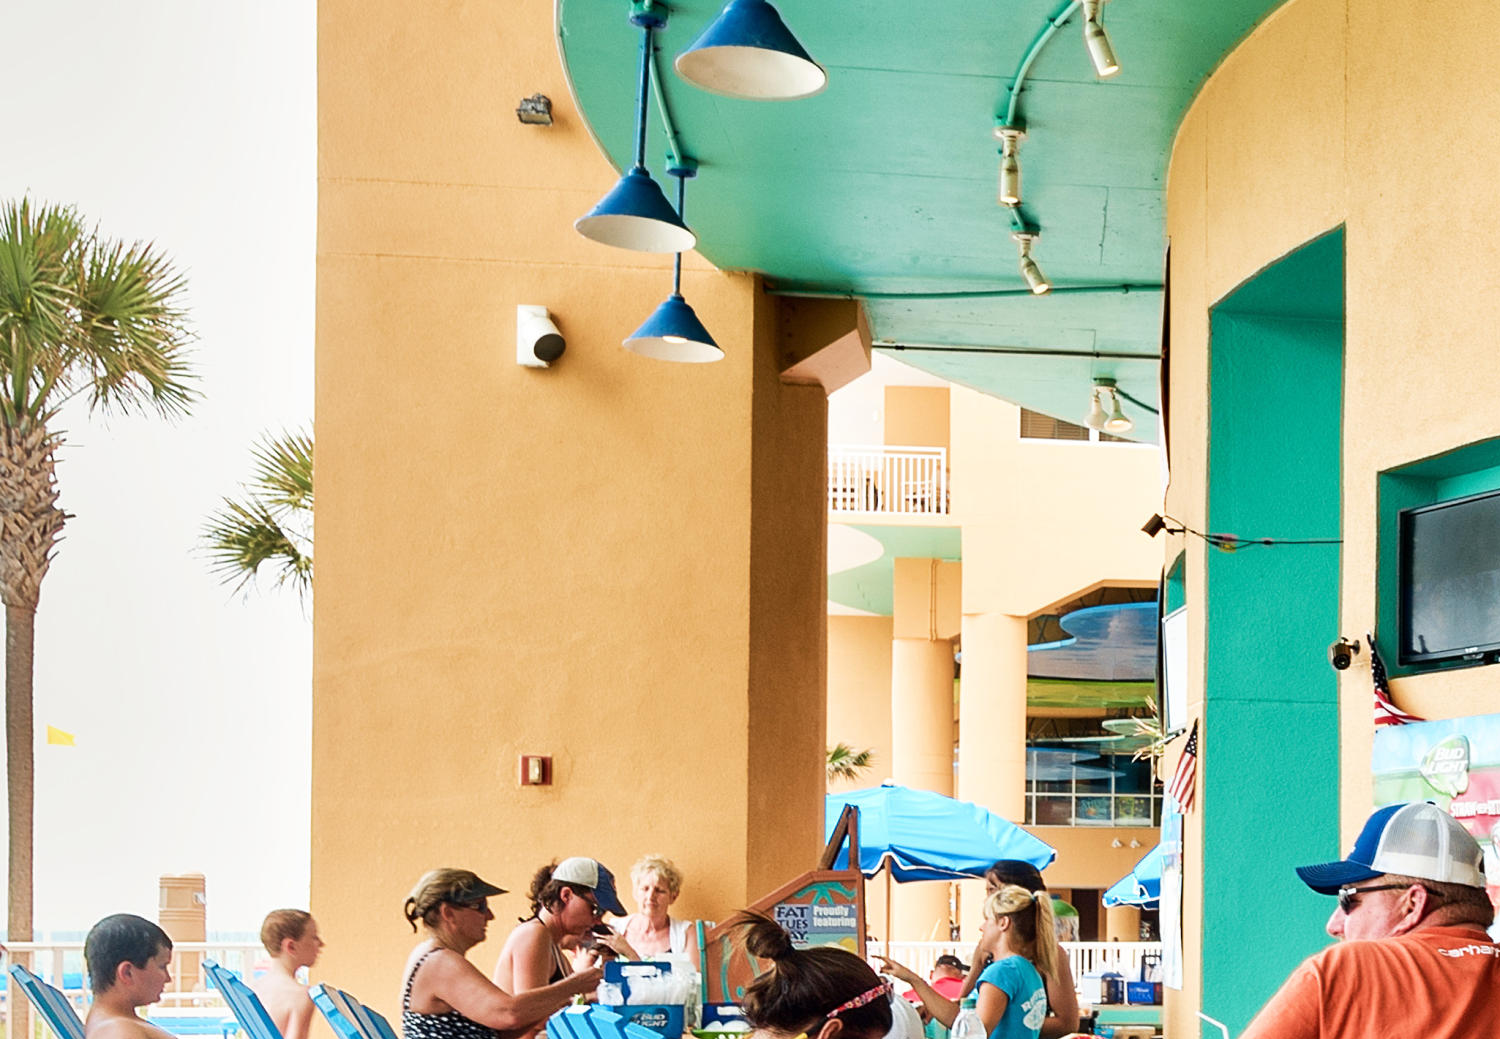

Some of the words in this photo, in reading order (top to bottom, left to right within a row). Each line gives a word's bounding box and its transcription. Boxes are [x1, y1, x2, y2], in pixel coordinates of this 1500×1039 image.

[1435, 747, 1465, 760] BUD
[1428, 760, 1468, 775] LIGHT
[777, 907, 809, 918] FAT
[813, 905, 849, 916] Proudly
[778, 919, 808, 929] TUES
[813, 917, 857, 928] featuring
